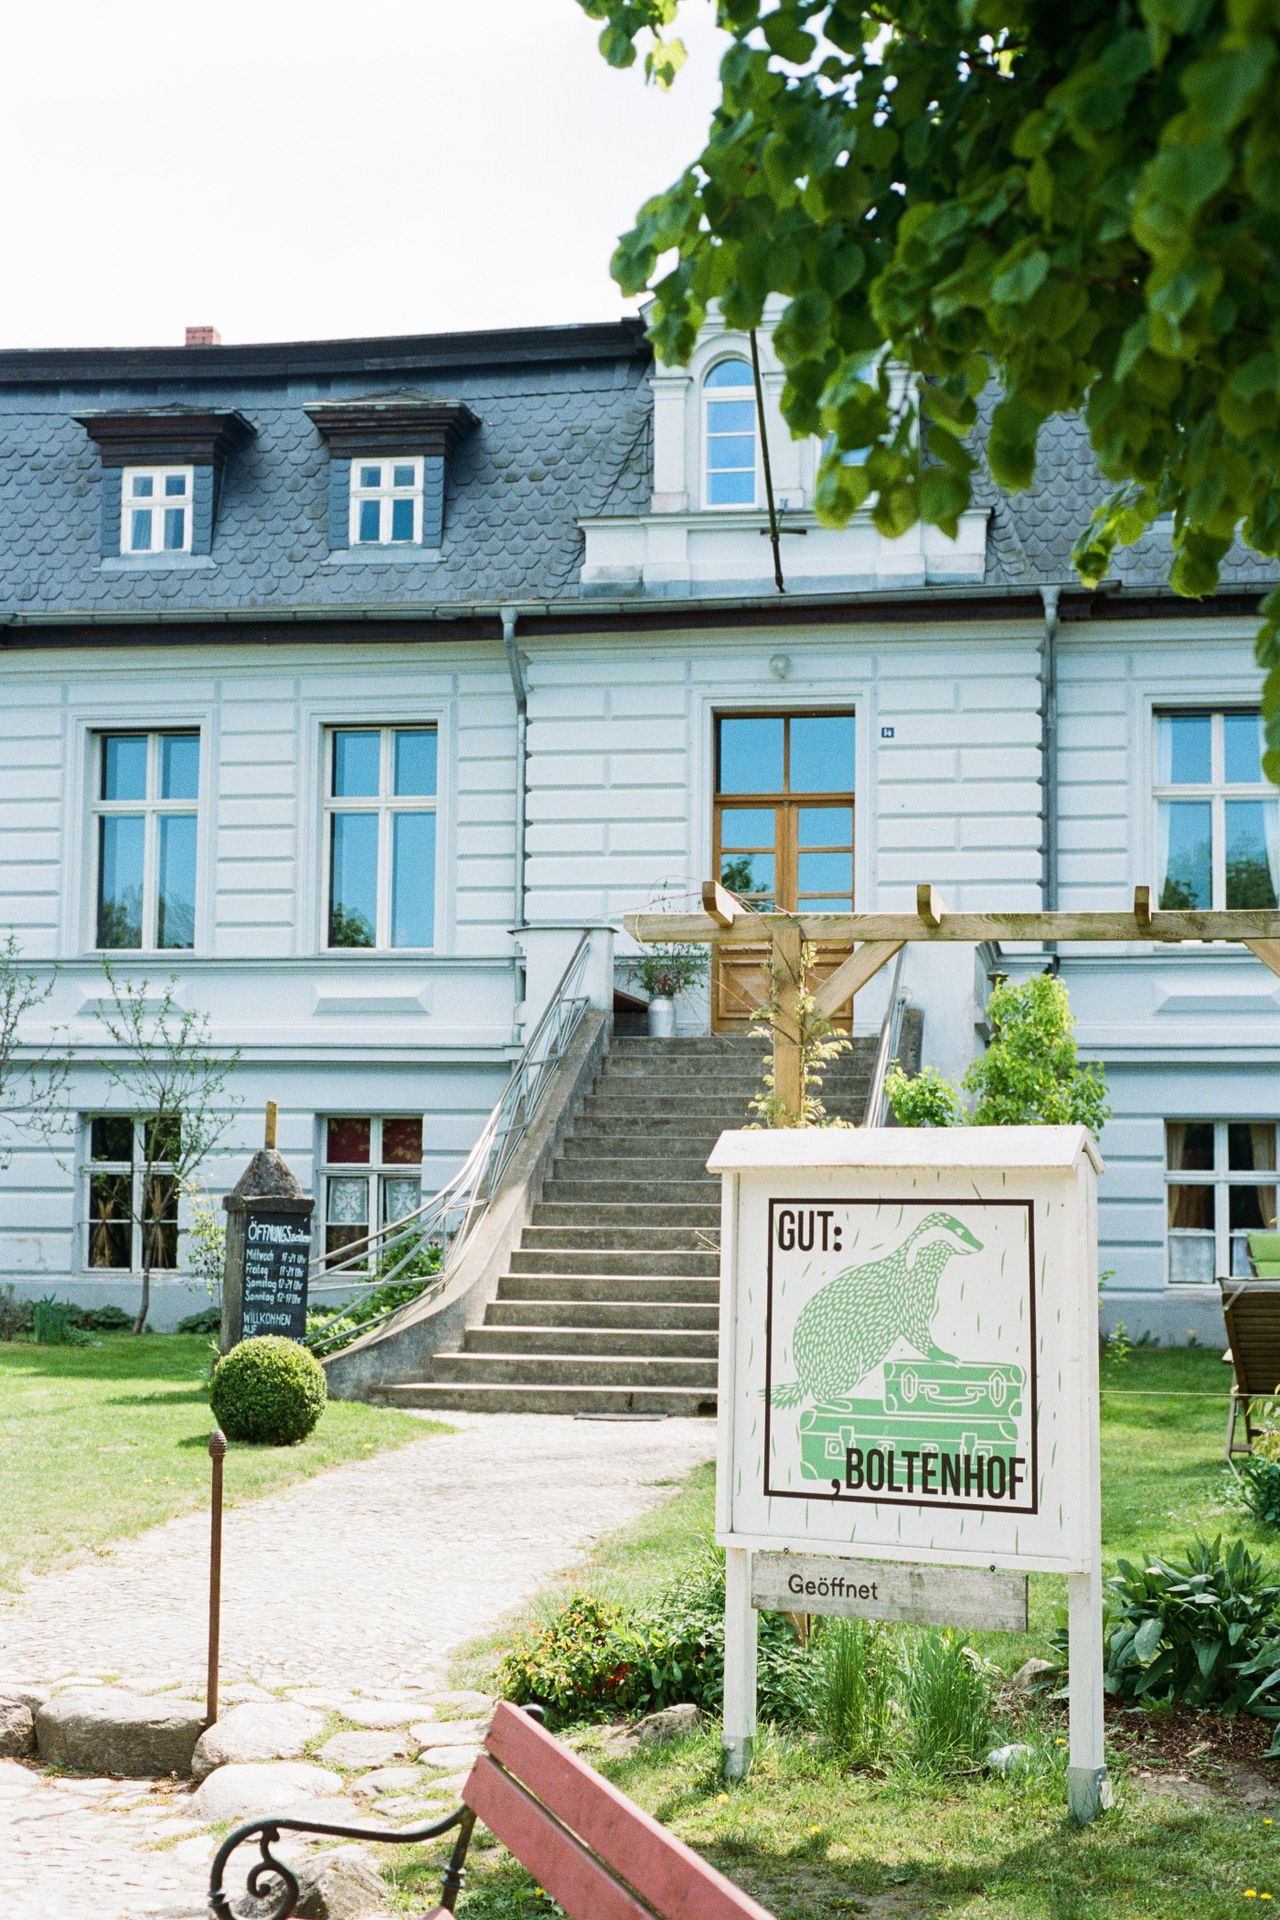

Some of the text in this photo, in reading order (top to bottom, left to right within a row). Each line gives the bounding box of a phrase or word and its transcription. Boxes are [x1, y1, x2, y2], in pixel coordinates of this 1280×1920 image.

[778, 1210, 842, 1252] GUT:
[246, 1248, 274, 1261] Mittwoch
[245, 1262, 269, 1278] Freitag
[246, 1276, 277, 1292] Samstag
[244, 1290, 275, 1305] Sonntag
[243, 1311, 292, 1326] WILLKOMMEN
[787, 1573, 878, 1600] Geöffnet
